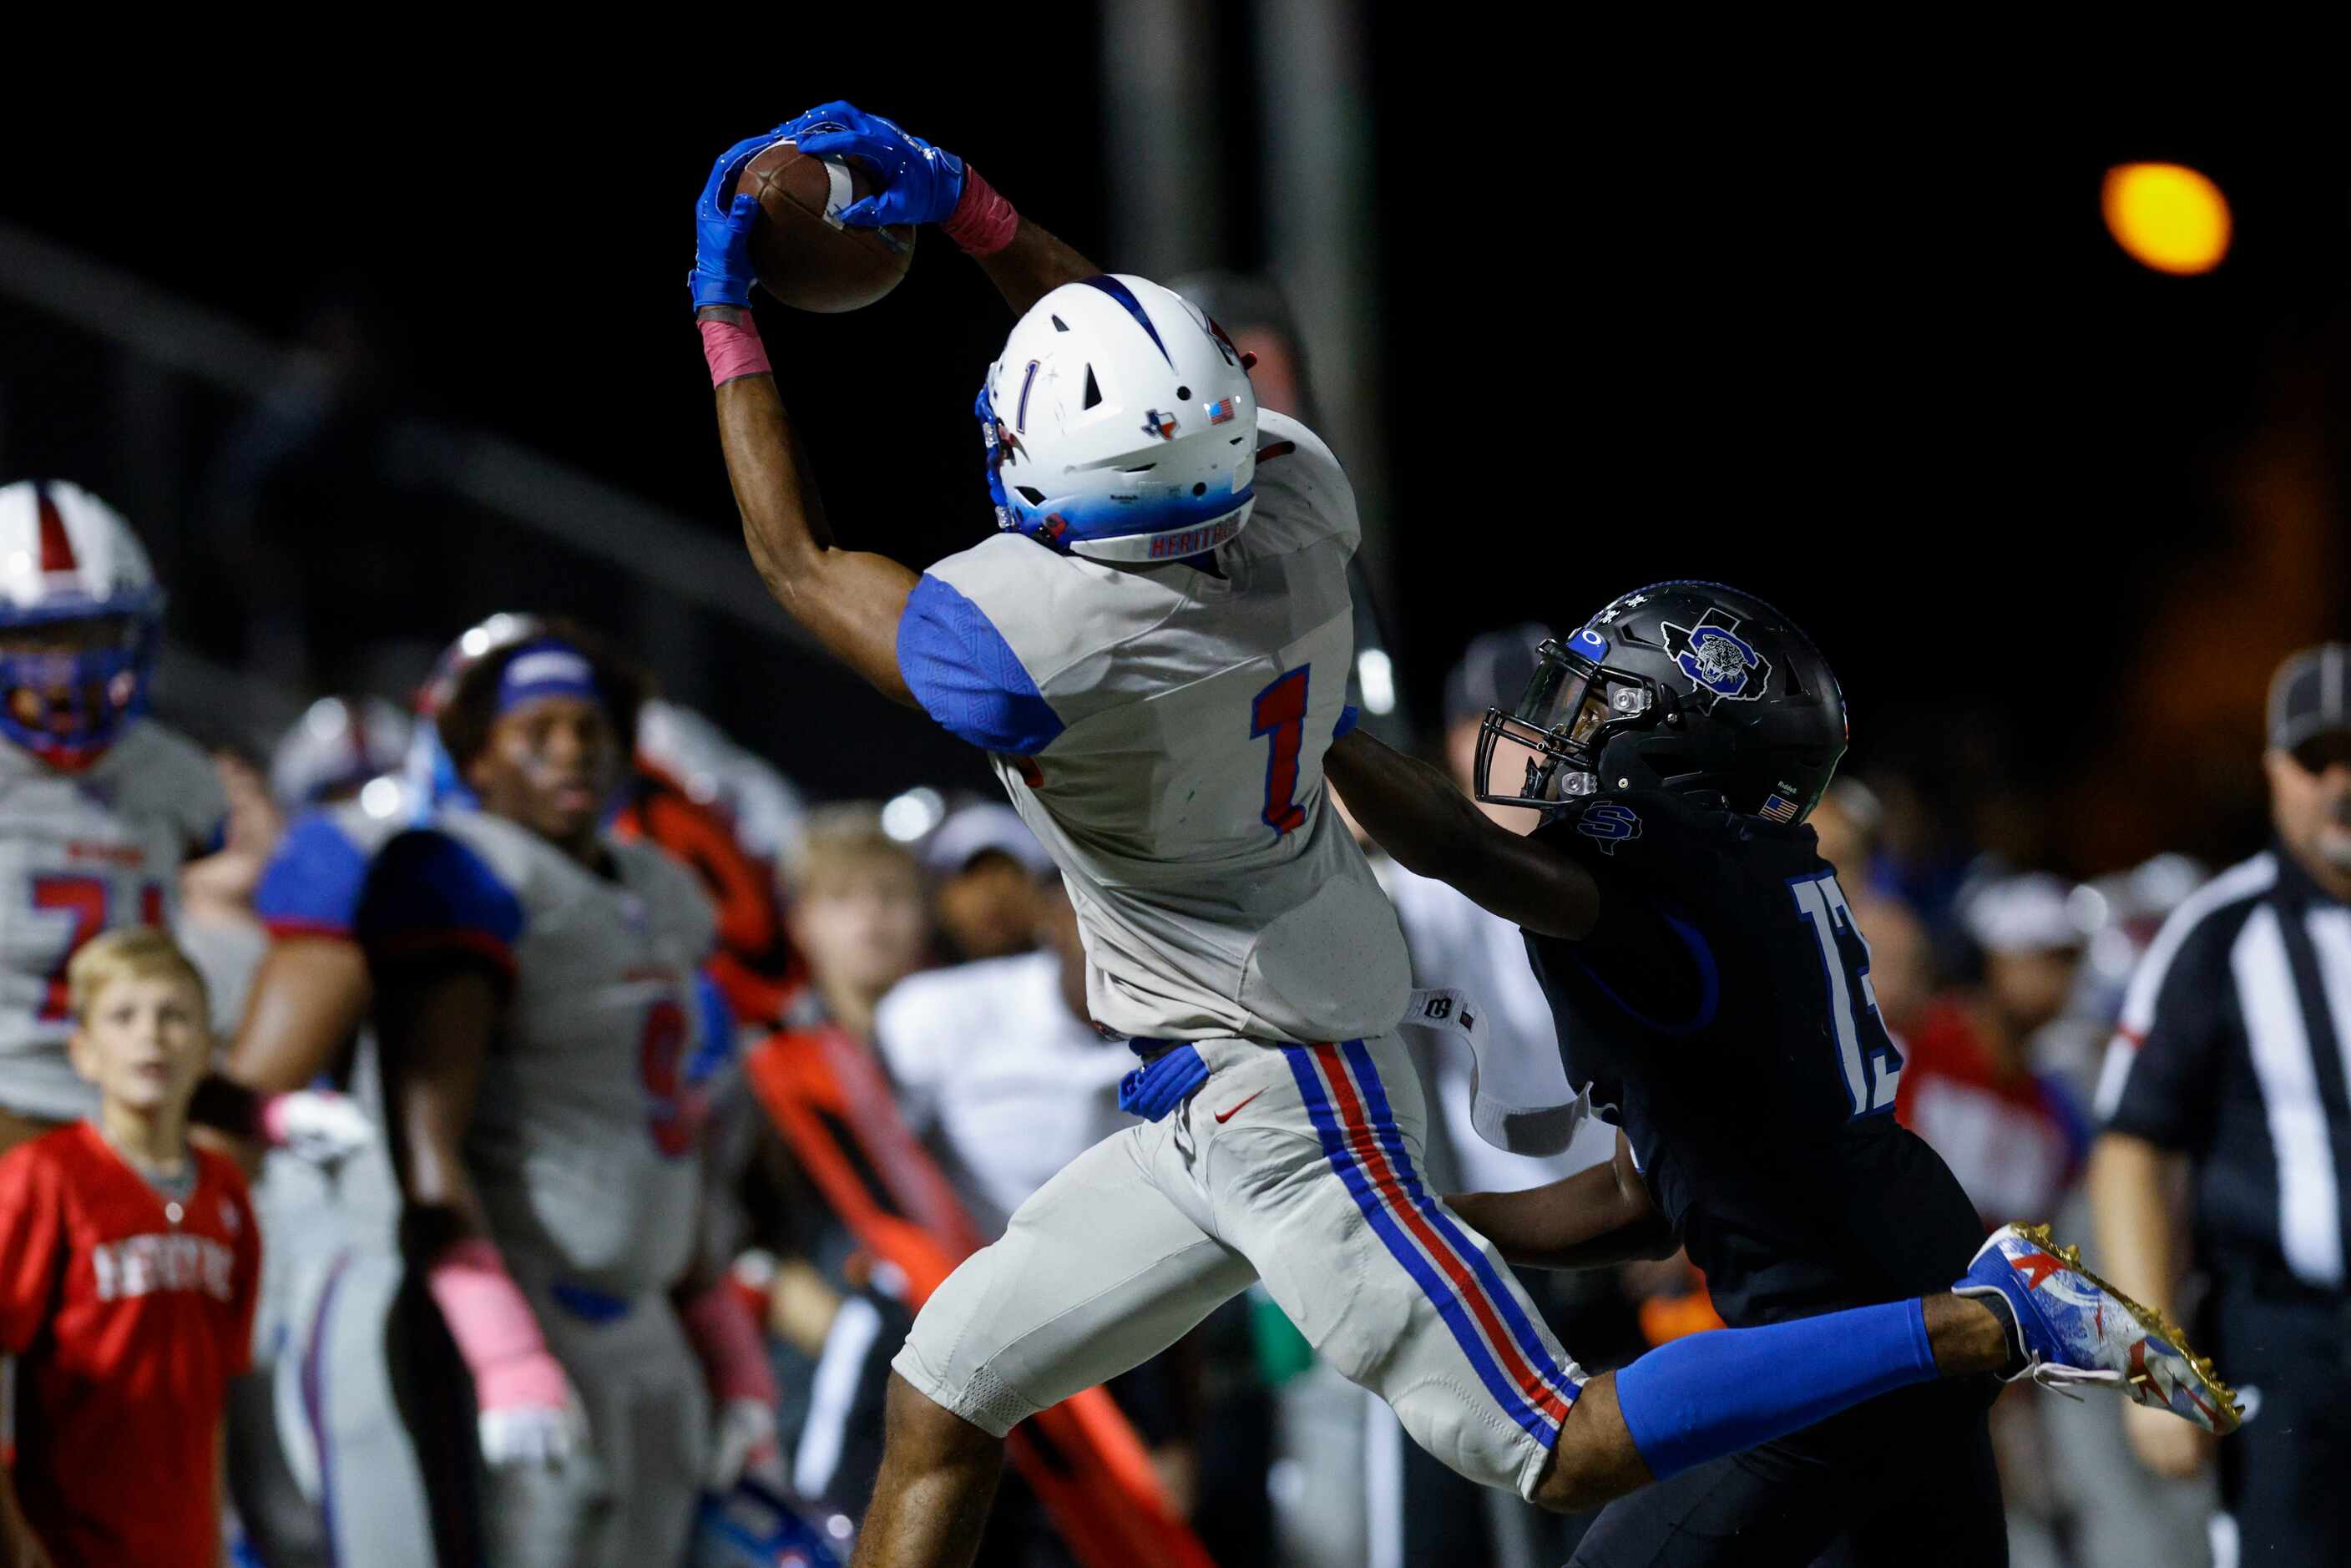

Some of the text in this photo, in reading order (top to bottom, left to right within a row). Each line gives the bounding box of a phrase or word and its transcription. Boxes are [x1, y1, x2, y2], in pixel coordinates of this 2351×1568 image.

[1015, 359, 1041, 435] 1
[1249, 662, 1311, 840] 1
[1576, 805, 1637, 840] S
